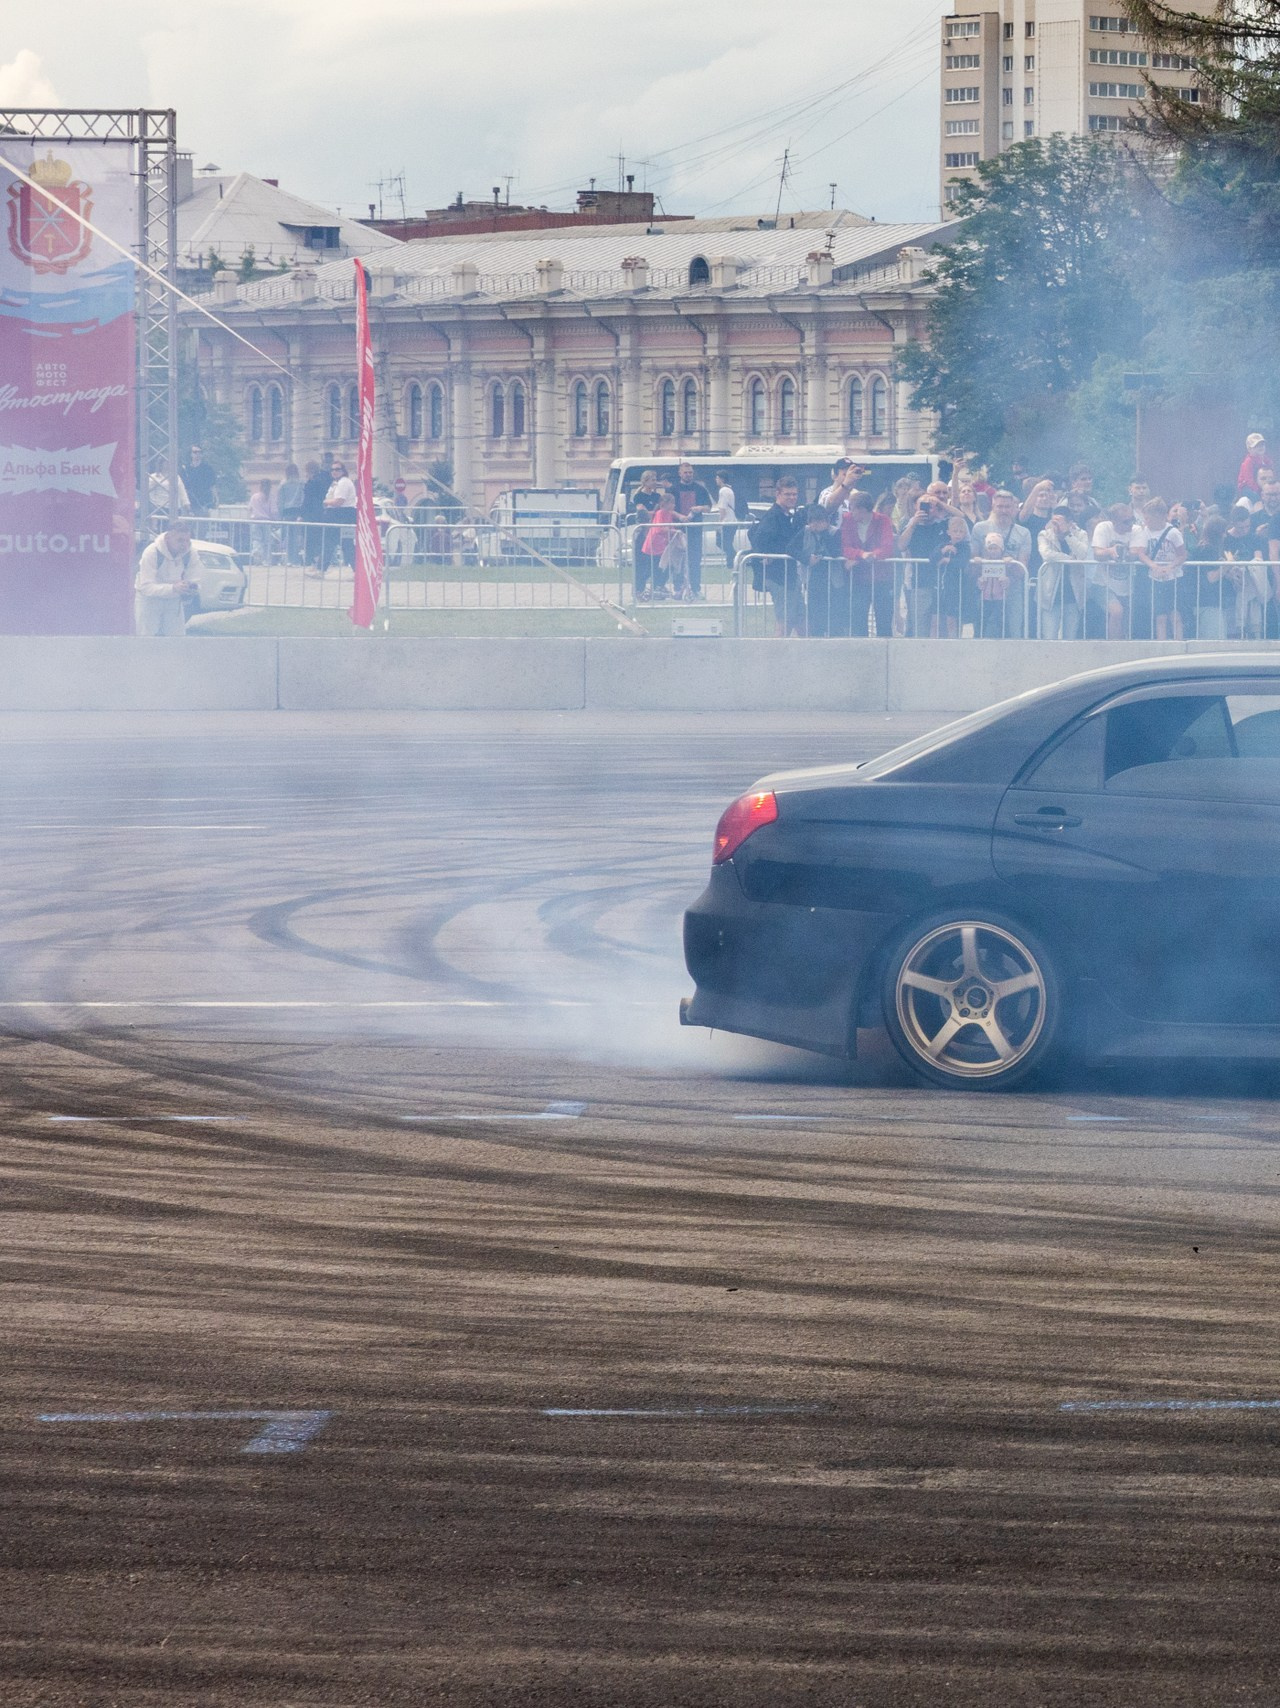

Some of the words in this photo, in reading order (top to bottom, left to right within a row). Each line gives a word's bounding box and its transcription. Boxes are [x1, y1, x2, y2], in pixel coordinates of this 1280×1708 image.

[36, 363, 67, 371] АВТО
[2, 460, 57, 481] Альфа
[60, 461, 102, 475] Банк
